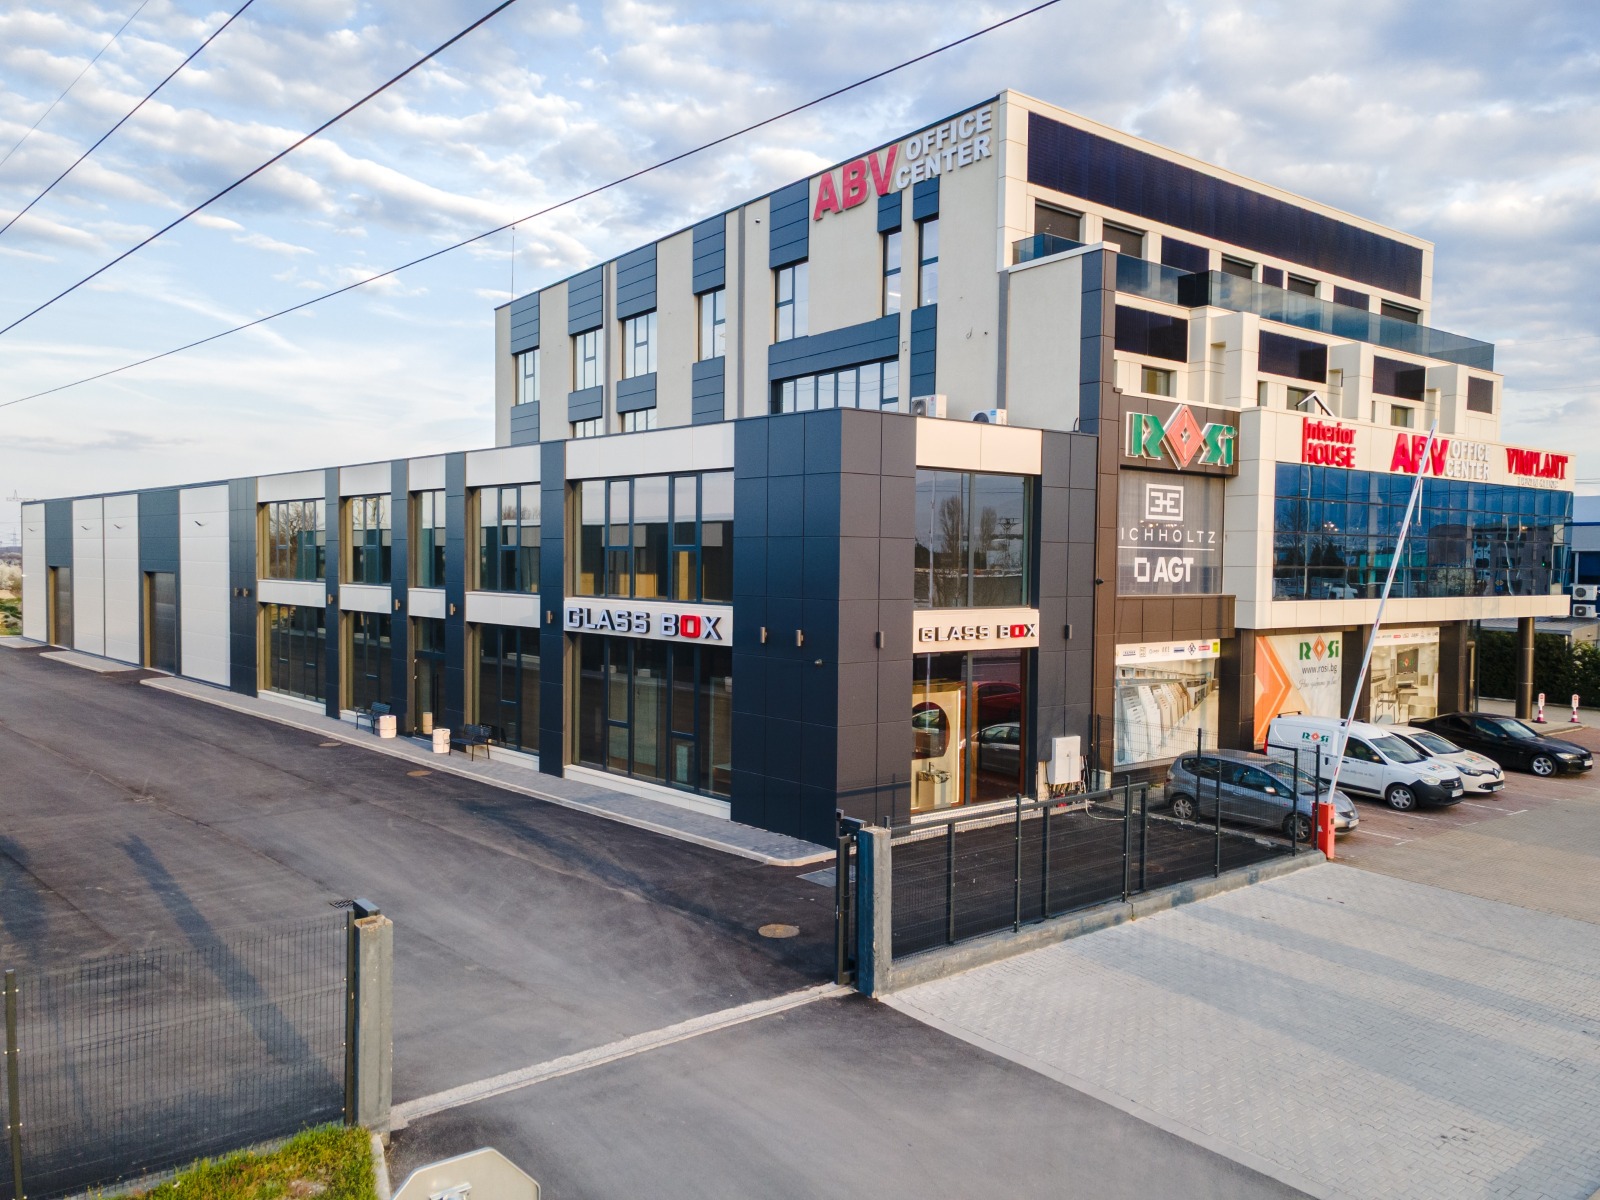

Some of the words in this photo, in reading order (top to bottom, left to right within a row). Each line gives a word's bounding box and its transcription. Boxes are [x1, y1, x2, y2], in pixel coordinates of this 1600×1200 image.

[905, 105, 993, 161] OFFICE
[895, 134, 992, 189] CENTER
[813, 144, 900, 221] ABV
[1302, 441, 1357, 468] HOUSE
[1390, 432, 1450, 476] ABV
[1450, 440, 1490, 462] OFFICE
[1445, 459, 1490, 480] CENTER
[566, 607, 650, 634] GLASS
[660, 613, 723, 640] BOX
[918, 625, 990, 642] GLASS
[996, 623, 1036, 639] BOX
[1301, 663, 1338, 675] www.rosi.bg
